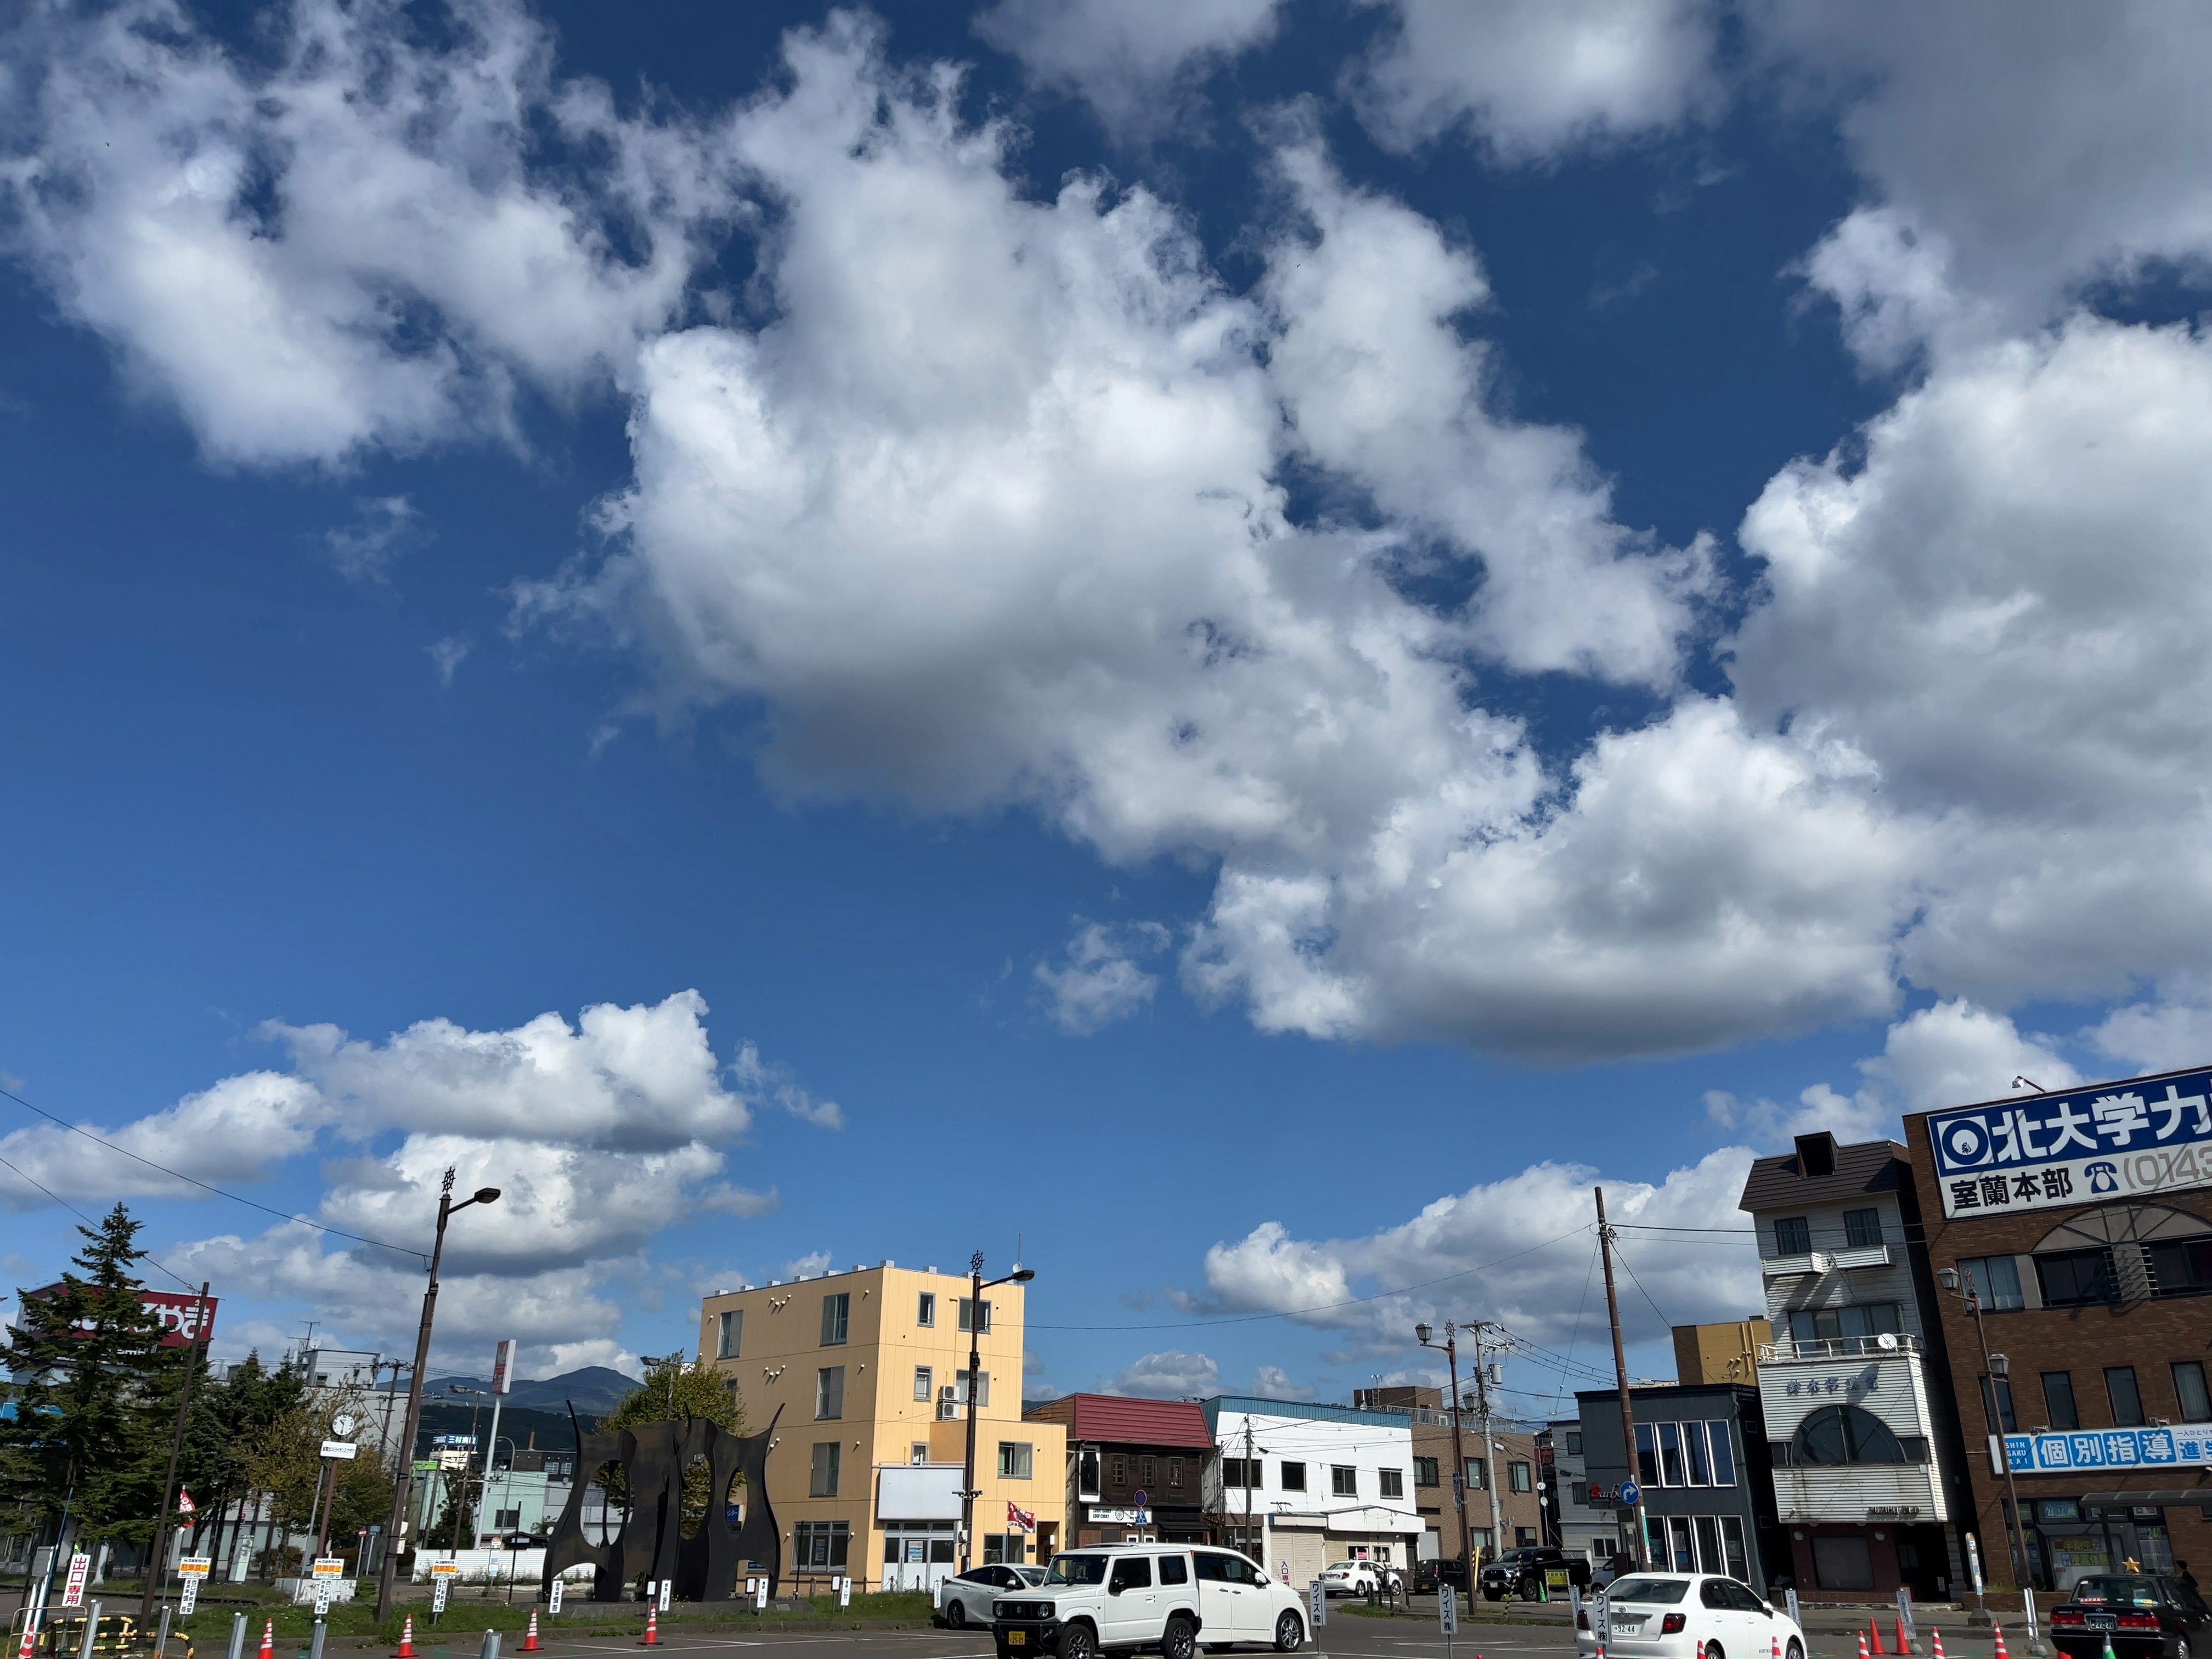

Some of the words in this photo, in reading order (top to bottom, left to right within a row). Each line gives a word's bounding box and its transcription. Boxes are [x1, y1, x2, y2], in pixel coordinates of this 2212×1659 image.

[1992, 1085, 2212, 1162] 北大学力
[1950, 1168, 2073, 1210] 室蘭本部
[2041, 1434, 2172, 1465] 個別指導
[65, 1557, 87, 1604] 出口専用
